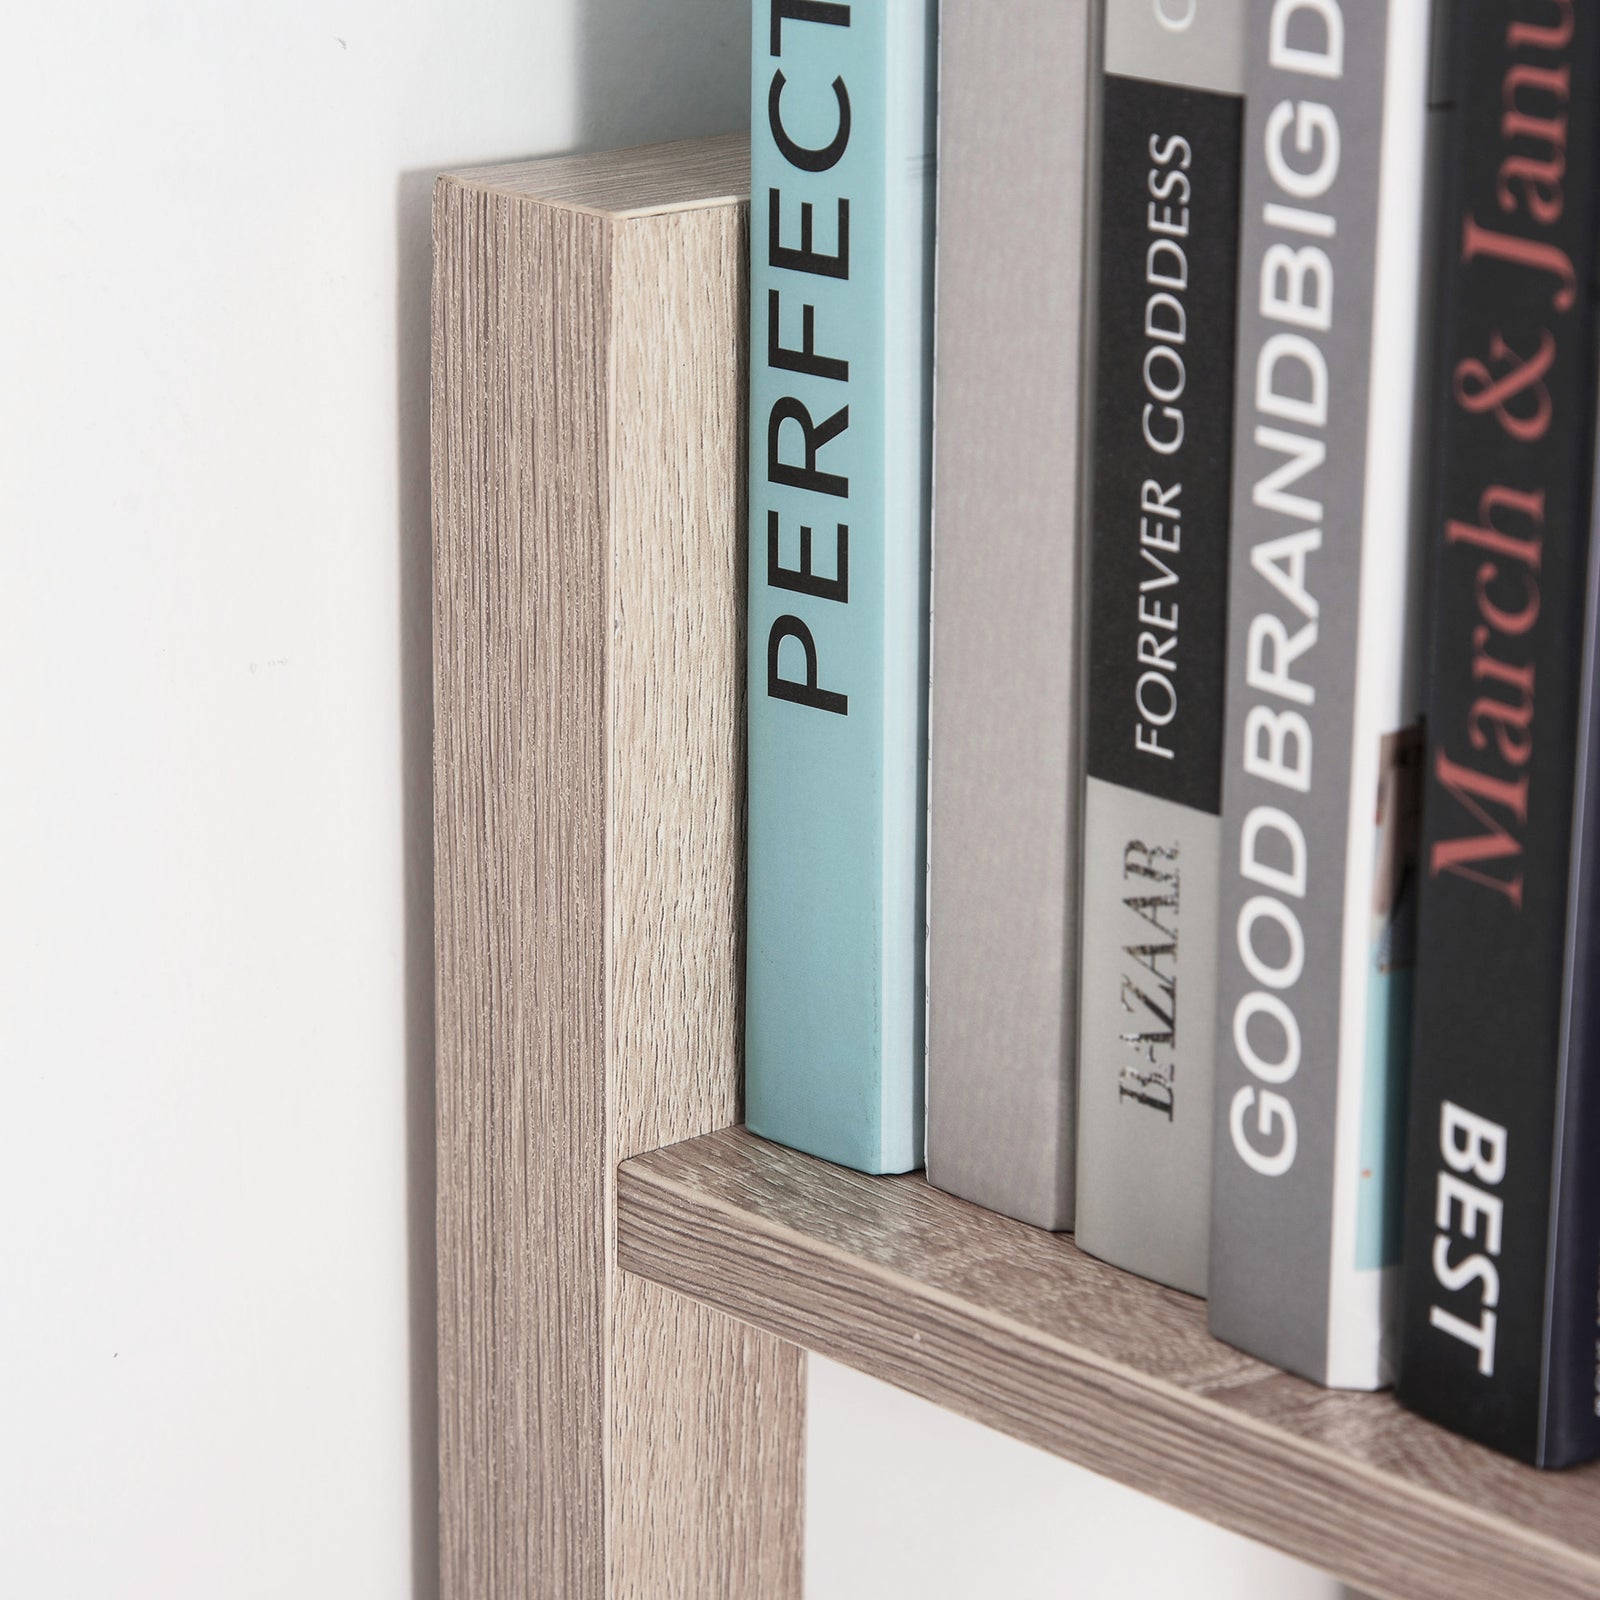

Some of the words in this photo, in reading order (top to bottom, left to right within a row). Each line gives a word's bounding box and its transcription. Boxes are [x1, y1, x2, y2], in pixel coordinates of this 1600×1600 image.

[768, 0, 851, 716] PERFECT
[1142, 133, 1192, 456] GODDESS
[1454, 328, 1556, 441] &
[1135, 479, 1183, 760] FOREVER
[1430, 484, 1546, 911] March
[1119, 840, 1180, 1123] BAZAAR
[1229, 805, 1308, 1177] GOOD
[1429, 1100, 1507, 1377] BEST
